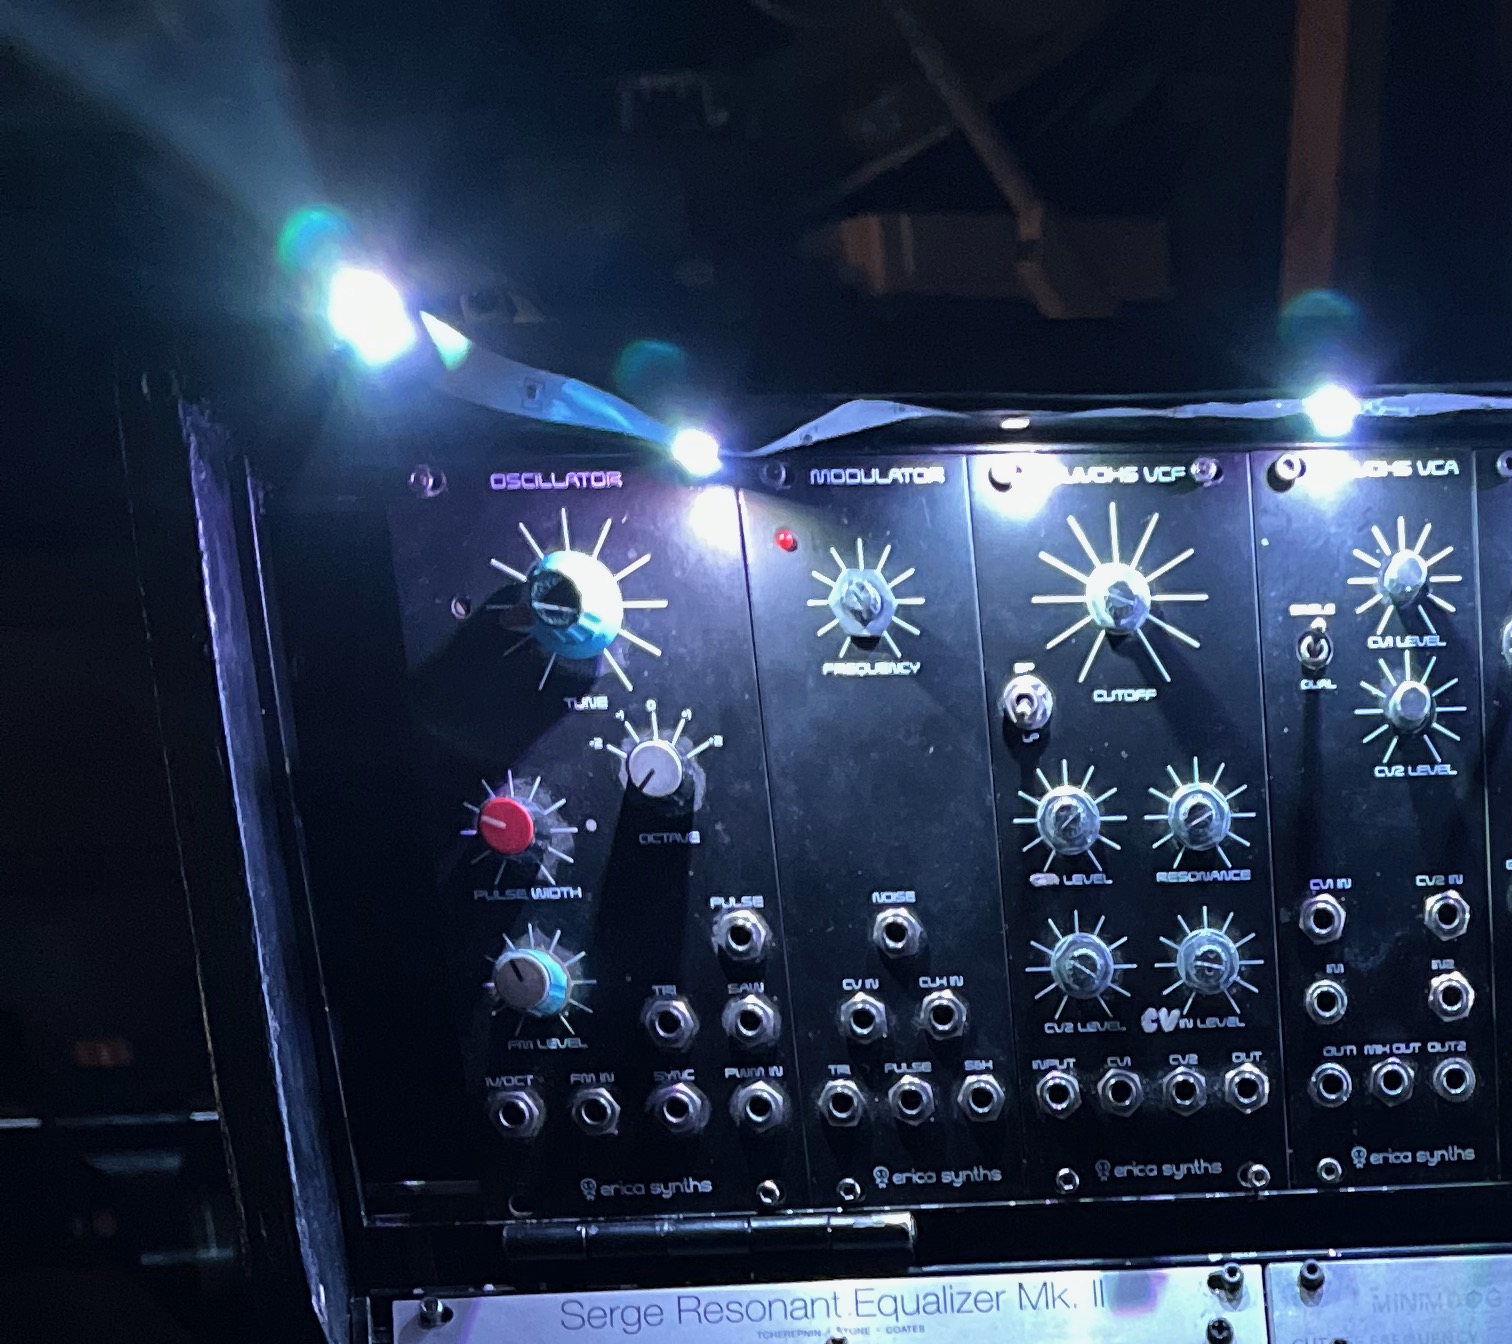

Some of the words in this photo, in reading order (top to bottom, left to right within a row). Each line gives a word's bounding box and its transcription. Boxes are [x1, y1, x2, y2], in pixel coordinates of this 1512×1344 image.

[1143, 465, 1187, 484] VCF
[1417, 460, 1459, 476] VCA
[490, 471, 623, 491] OSCILLATOR
[809, 466, 945, 485] MODULATOR
[1093, 689, 1157, 702] CUTOFF
[566, 696, 608, 710] TUNE
[639, 832, 700, 846] OCTAVE
[1063, 875, 1113, 886] LEVEL
[1156, 869, 1252, 883] RESONANCE
[474, 889, 526, 901] PULSE
[531, 887, 582, 900] WIDTH
[872, 891, 916, 904] NOISE
[710, 896, 764, 909] PULSE
[1032, 1057, 1075, 1070] INPUT
[1232, 1050, 1261, 1063] OUT
[654, 1067, 695, 1081] SYNC
[600, 1179, 645, 1196] erica
[650, 1177, 712, 1199] synths
[561, 1299, 663, 1336] Serge
[678, 1290, 841, 1325] Resonant
[855, 1286, 1006, 1321] Equalizer
[1017, 1282, 1078, 1311] Mk.
[1093, 1279, 1107, 1309] II
